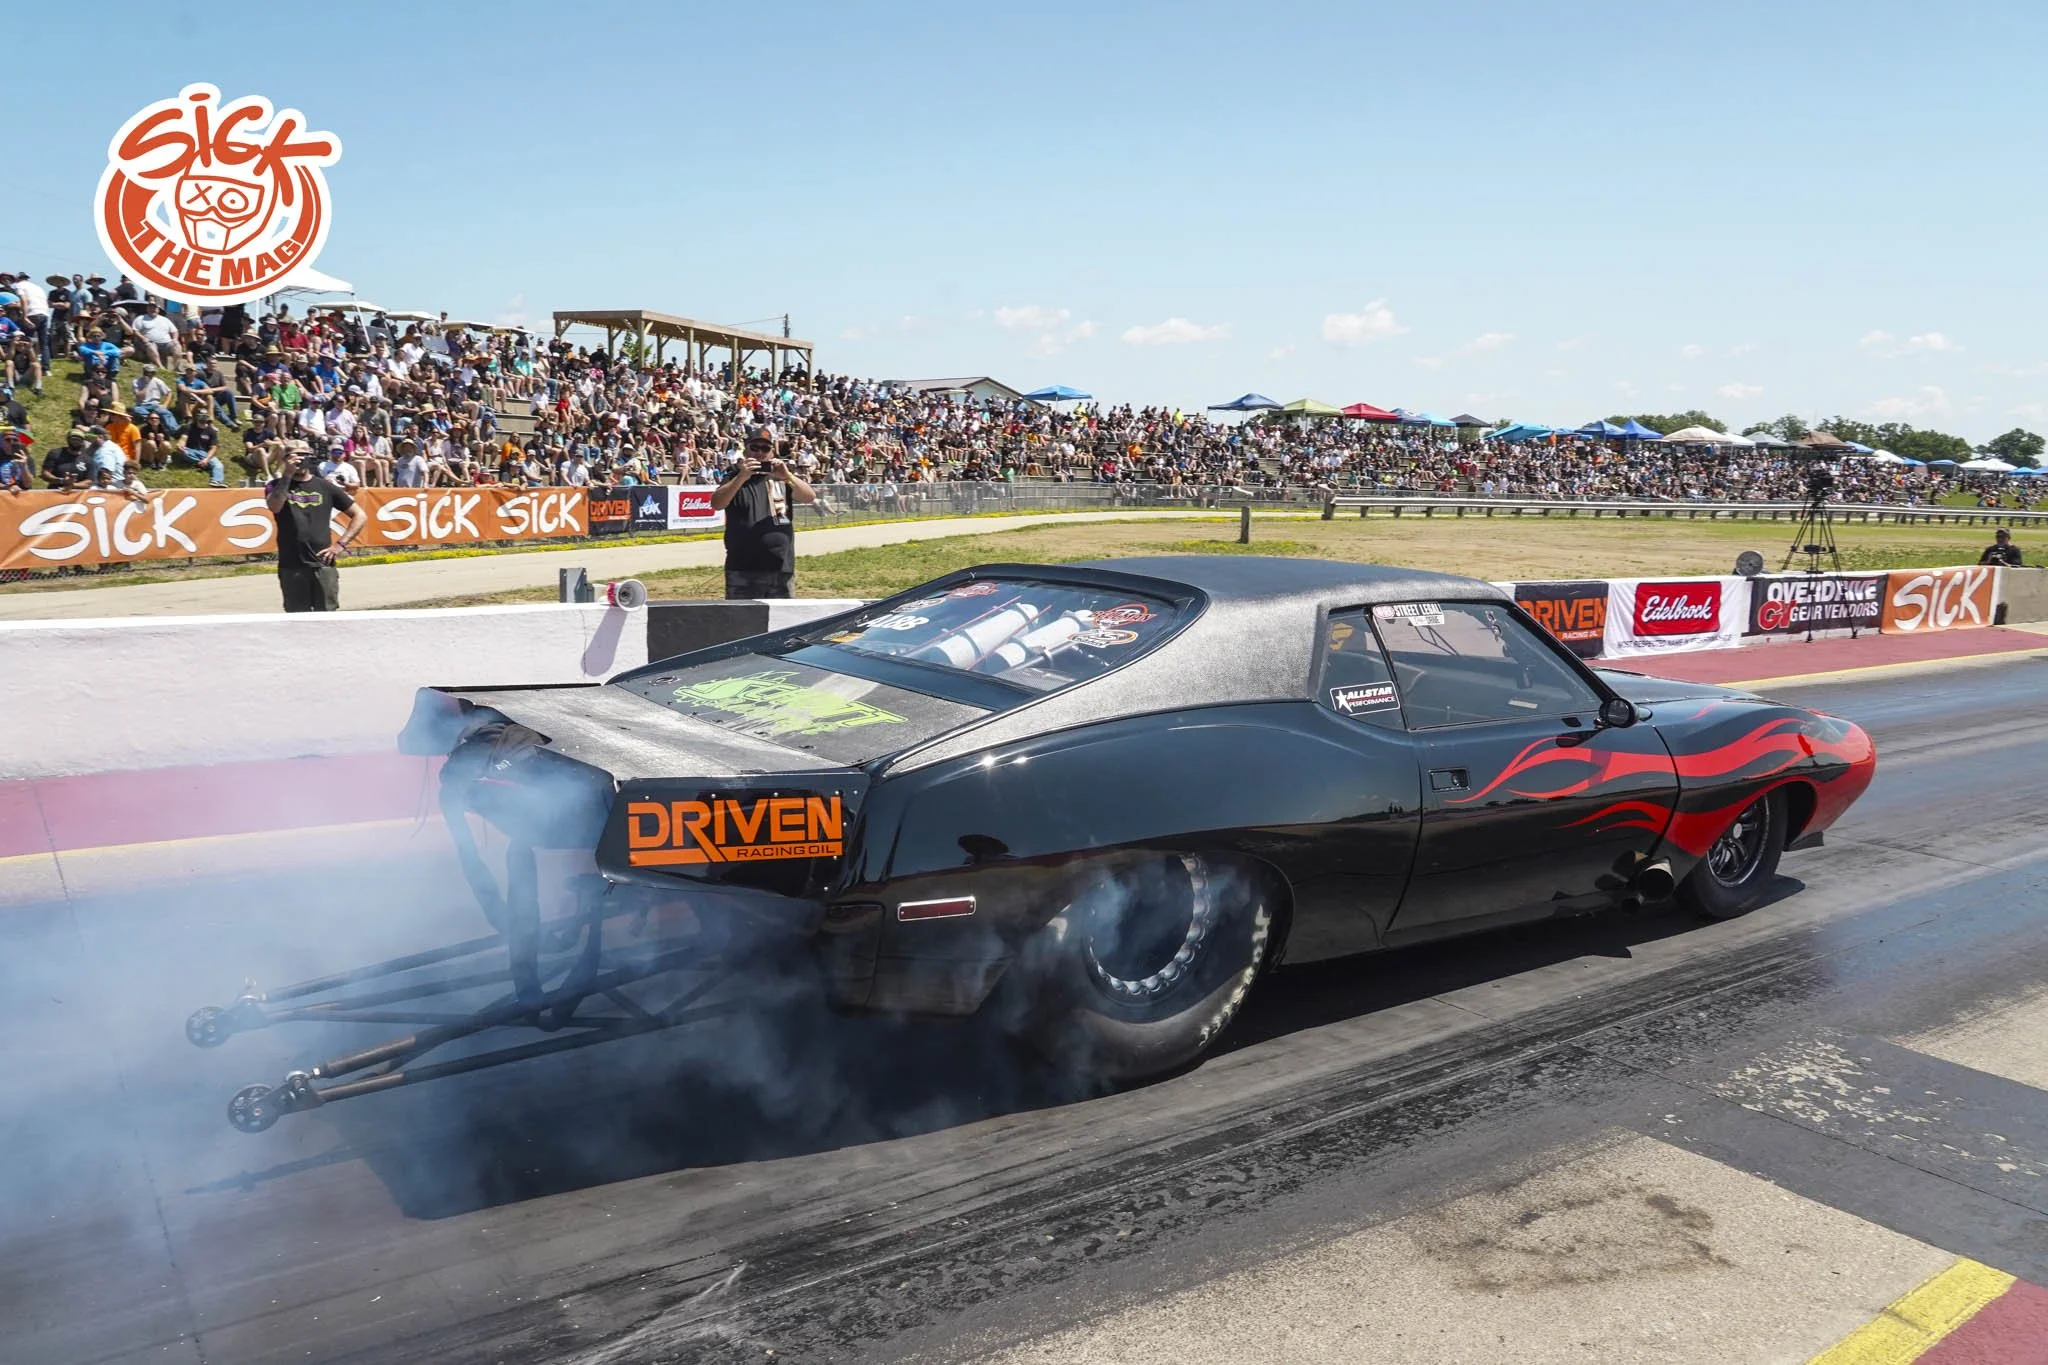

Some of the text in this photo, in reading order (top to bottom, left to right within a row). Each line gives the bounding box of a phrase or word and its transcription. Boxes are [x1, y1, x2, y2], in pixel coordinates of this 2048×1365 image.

[1393, 604, 1420, 617] STREET
[1641, 594, 1712, 622] Edelbrock
[1347, 686, 1393, 700] ALLSTAR
[1348, 696, 1395, 707] PERFORMANCE
[627, 796, 843, 862] DRIVEN
[736, 845, 836, 858] RACING OIL
